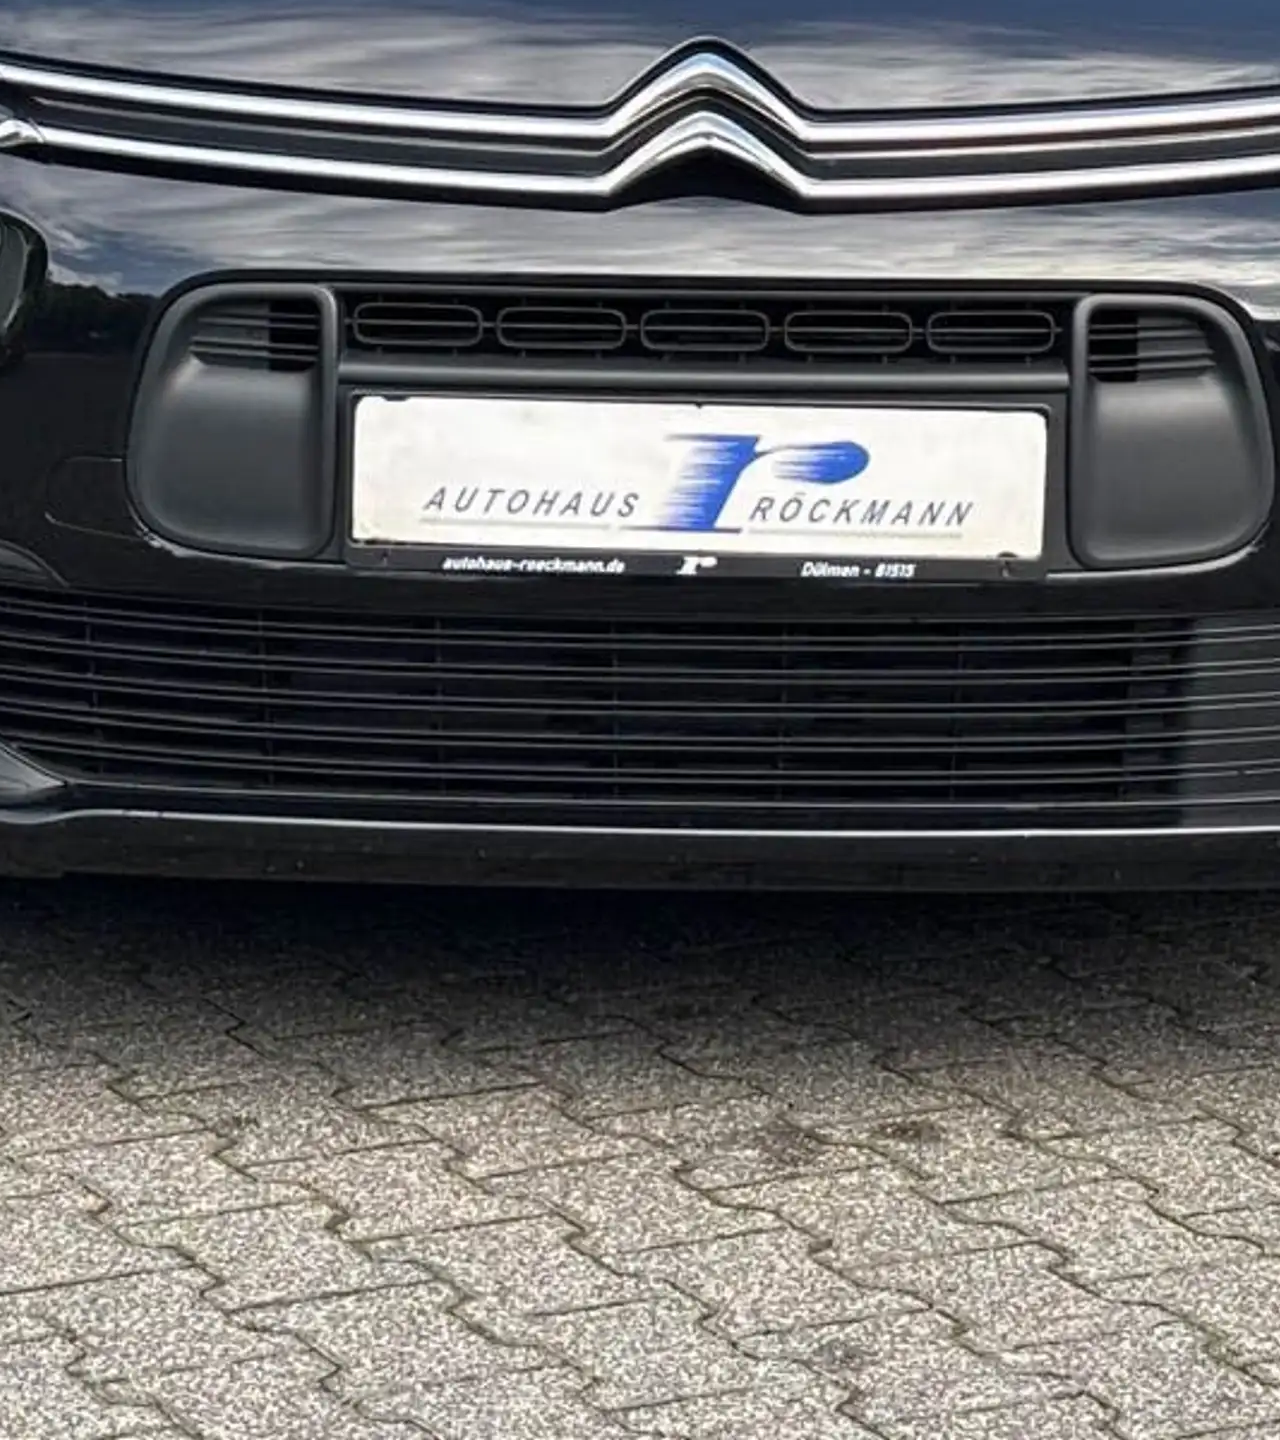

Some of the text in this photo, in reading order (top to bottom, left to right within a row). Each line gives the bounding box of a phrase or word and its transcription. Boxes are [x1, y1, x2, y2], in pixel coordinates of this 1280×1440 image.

[422, 486, 974, 527] AUTOHAUS RÖCKMANN
[800, 561, 860, 578] Dülmen
